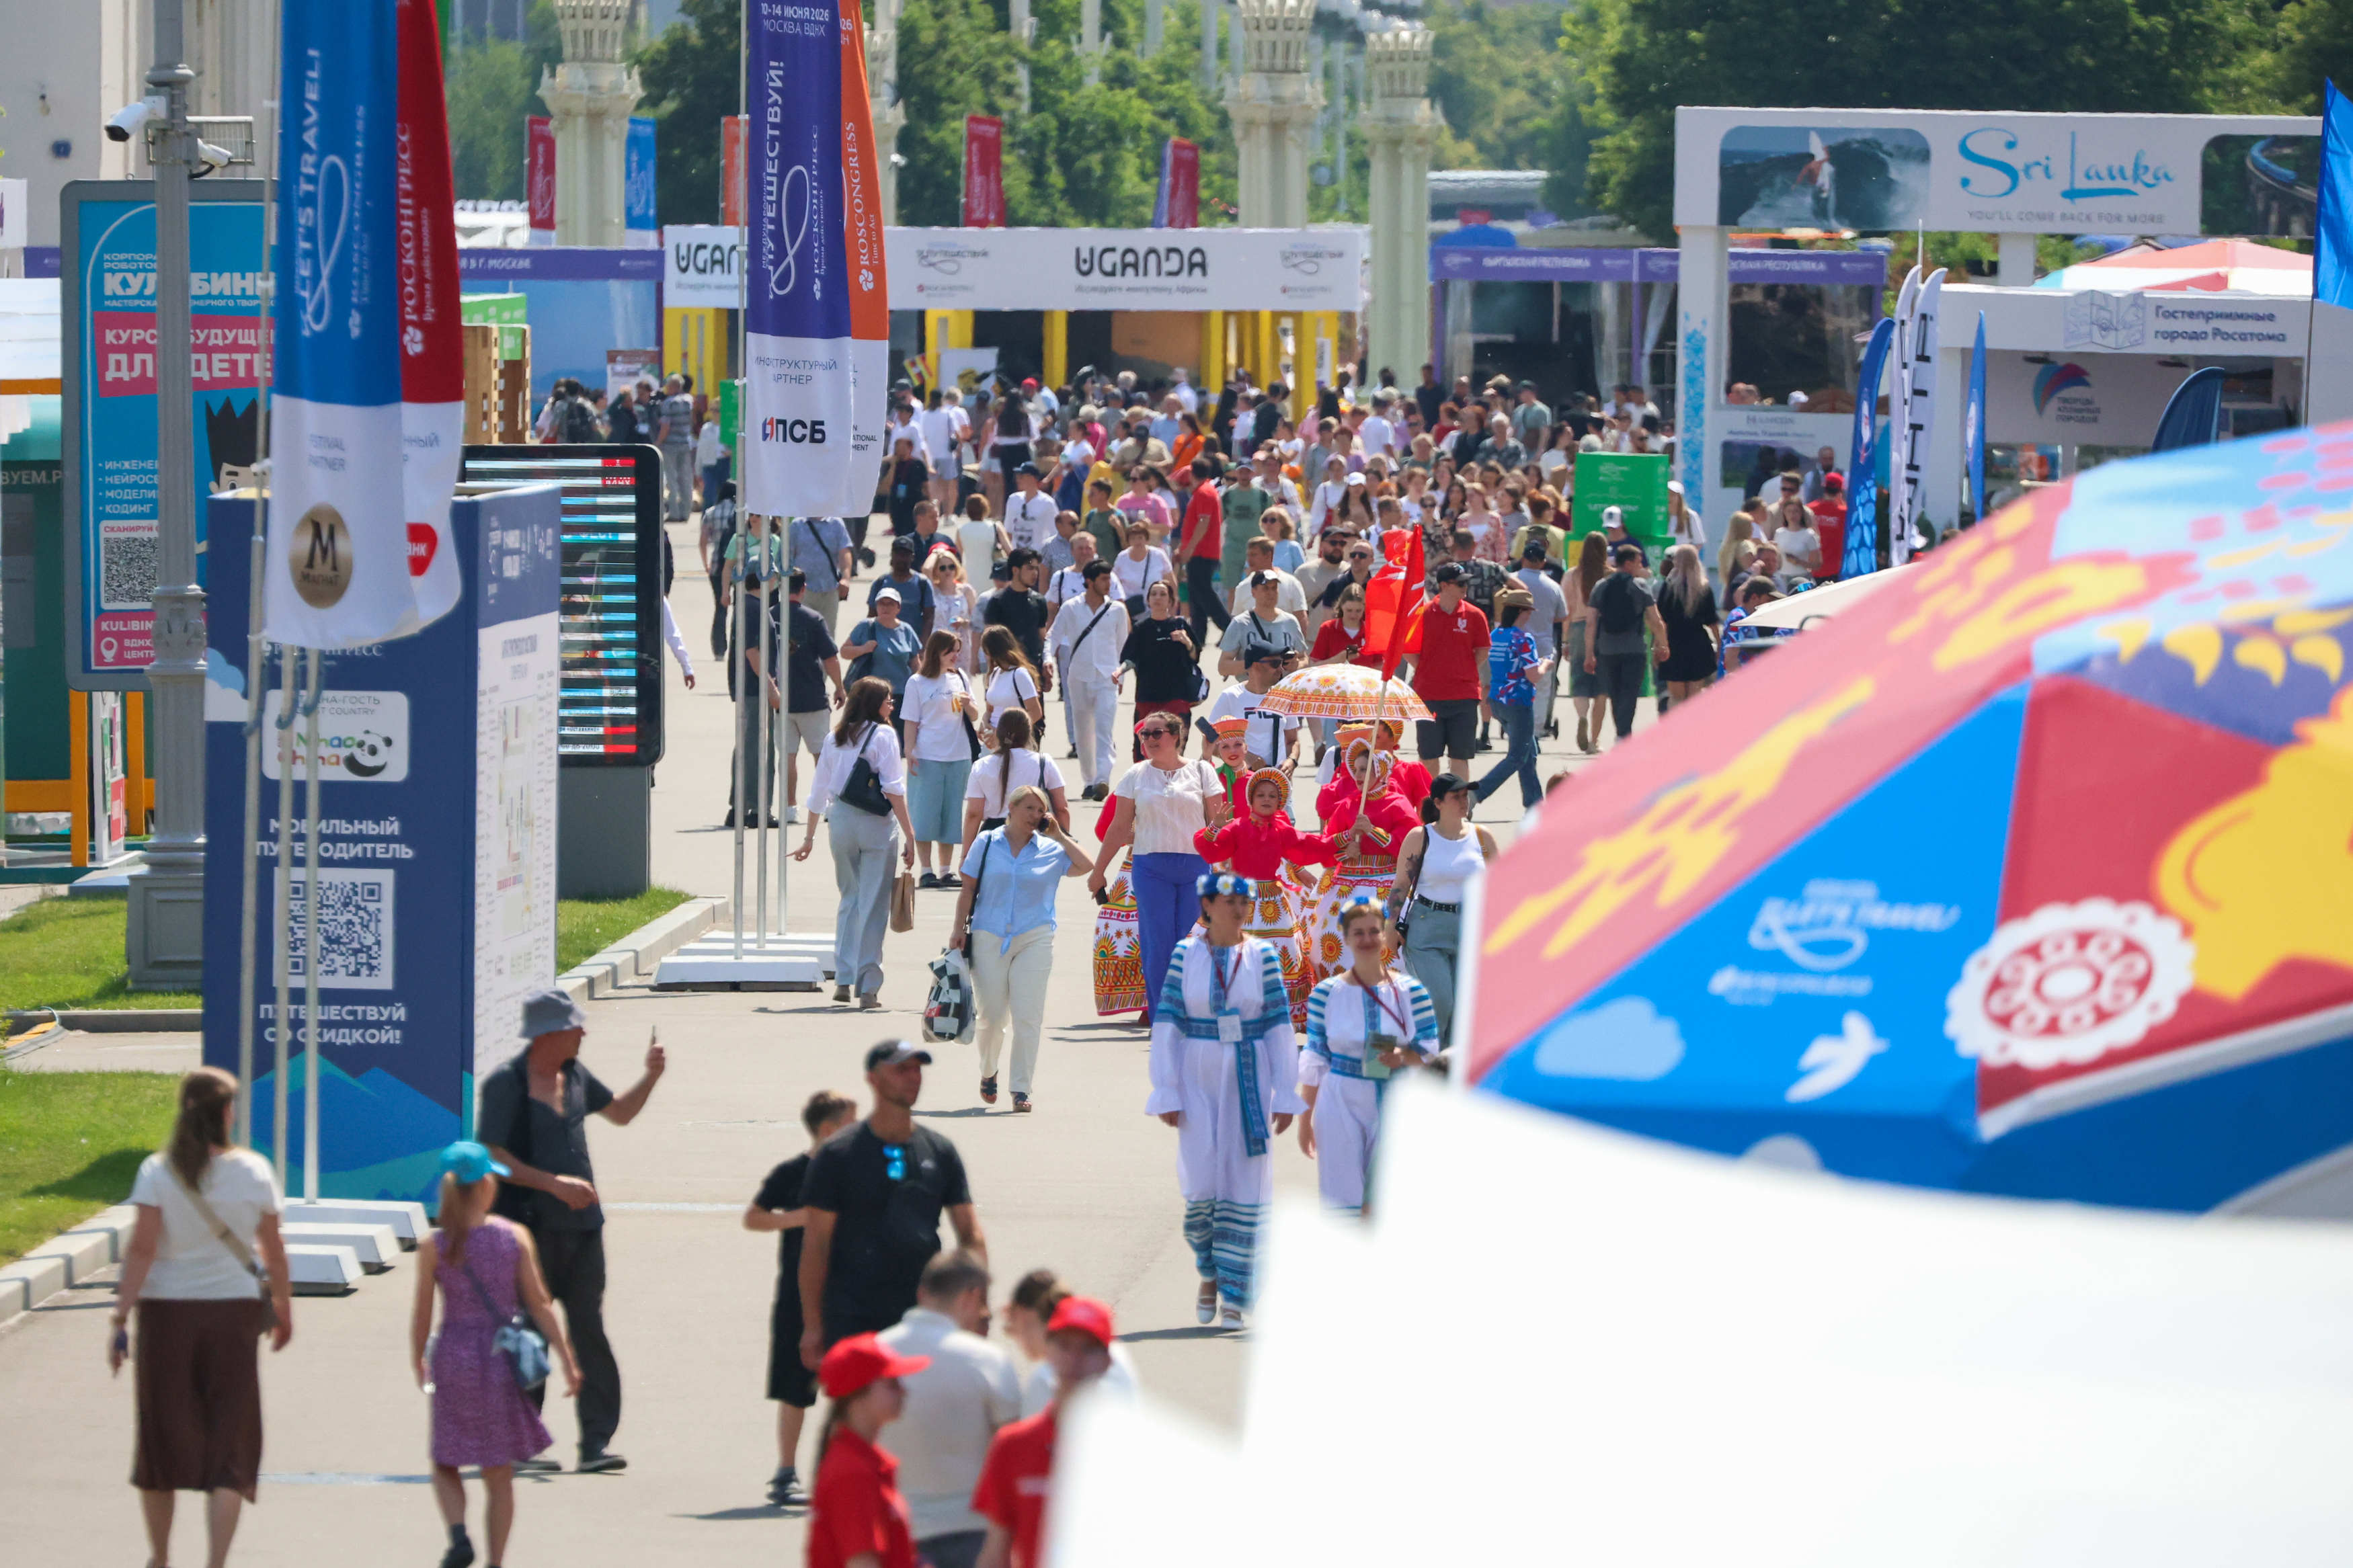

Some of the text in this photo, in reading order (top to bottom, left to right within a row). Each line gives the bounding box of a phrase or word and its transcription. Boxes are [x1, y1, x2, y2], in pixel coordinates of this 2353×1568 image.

[761, 3, 830, 22] 10-14 ИЮНЯ 2026
[763, 18, 826, 36] МОСКВА ВДНХ
[297, 48, 321, 298] LET'S TRAVEL!
[765, 60, 785, 271] ПУТЕШЕСТВУЙ!
[1958, 127, 2177, 205] Sri Lanka
[845, 122, 870, 266] ROSCONGRESS
[2060, 212, 2093, 222] BACK
[2098, 212, 2122, 223] FOR
[871, 231, 877, 241] to
[1075, 247, 1208, 278] UGANDA
[104, 272, 276, 295] КУЛБИН
[2155, 304, 2276, 324] Гостеприимные
[2154, 327, 2287, 343] города Росатома
[105, 353, 154, 381] ДЛ
[773, 373, 813, 385] АРТНЕР
[775, 418, 826, 444] ПСБ
[105, 503, 153, 514] КОДИНГ
[104, 523, 153, 533] СКАНИРУЙ
[328, 707, 375, 715] COUNTRY
[255, 841, 414, 860] ПУЕОДИТЕЛЬ
[259, 1002, 406, 1022] ПТЕШЕСТВУЙ
